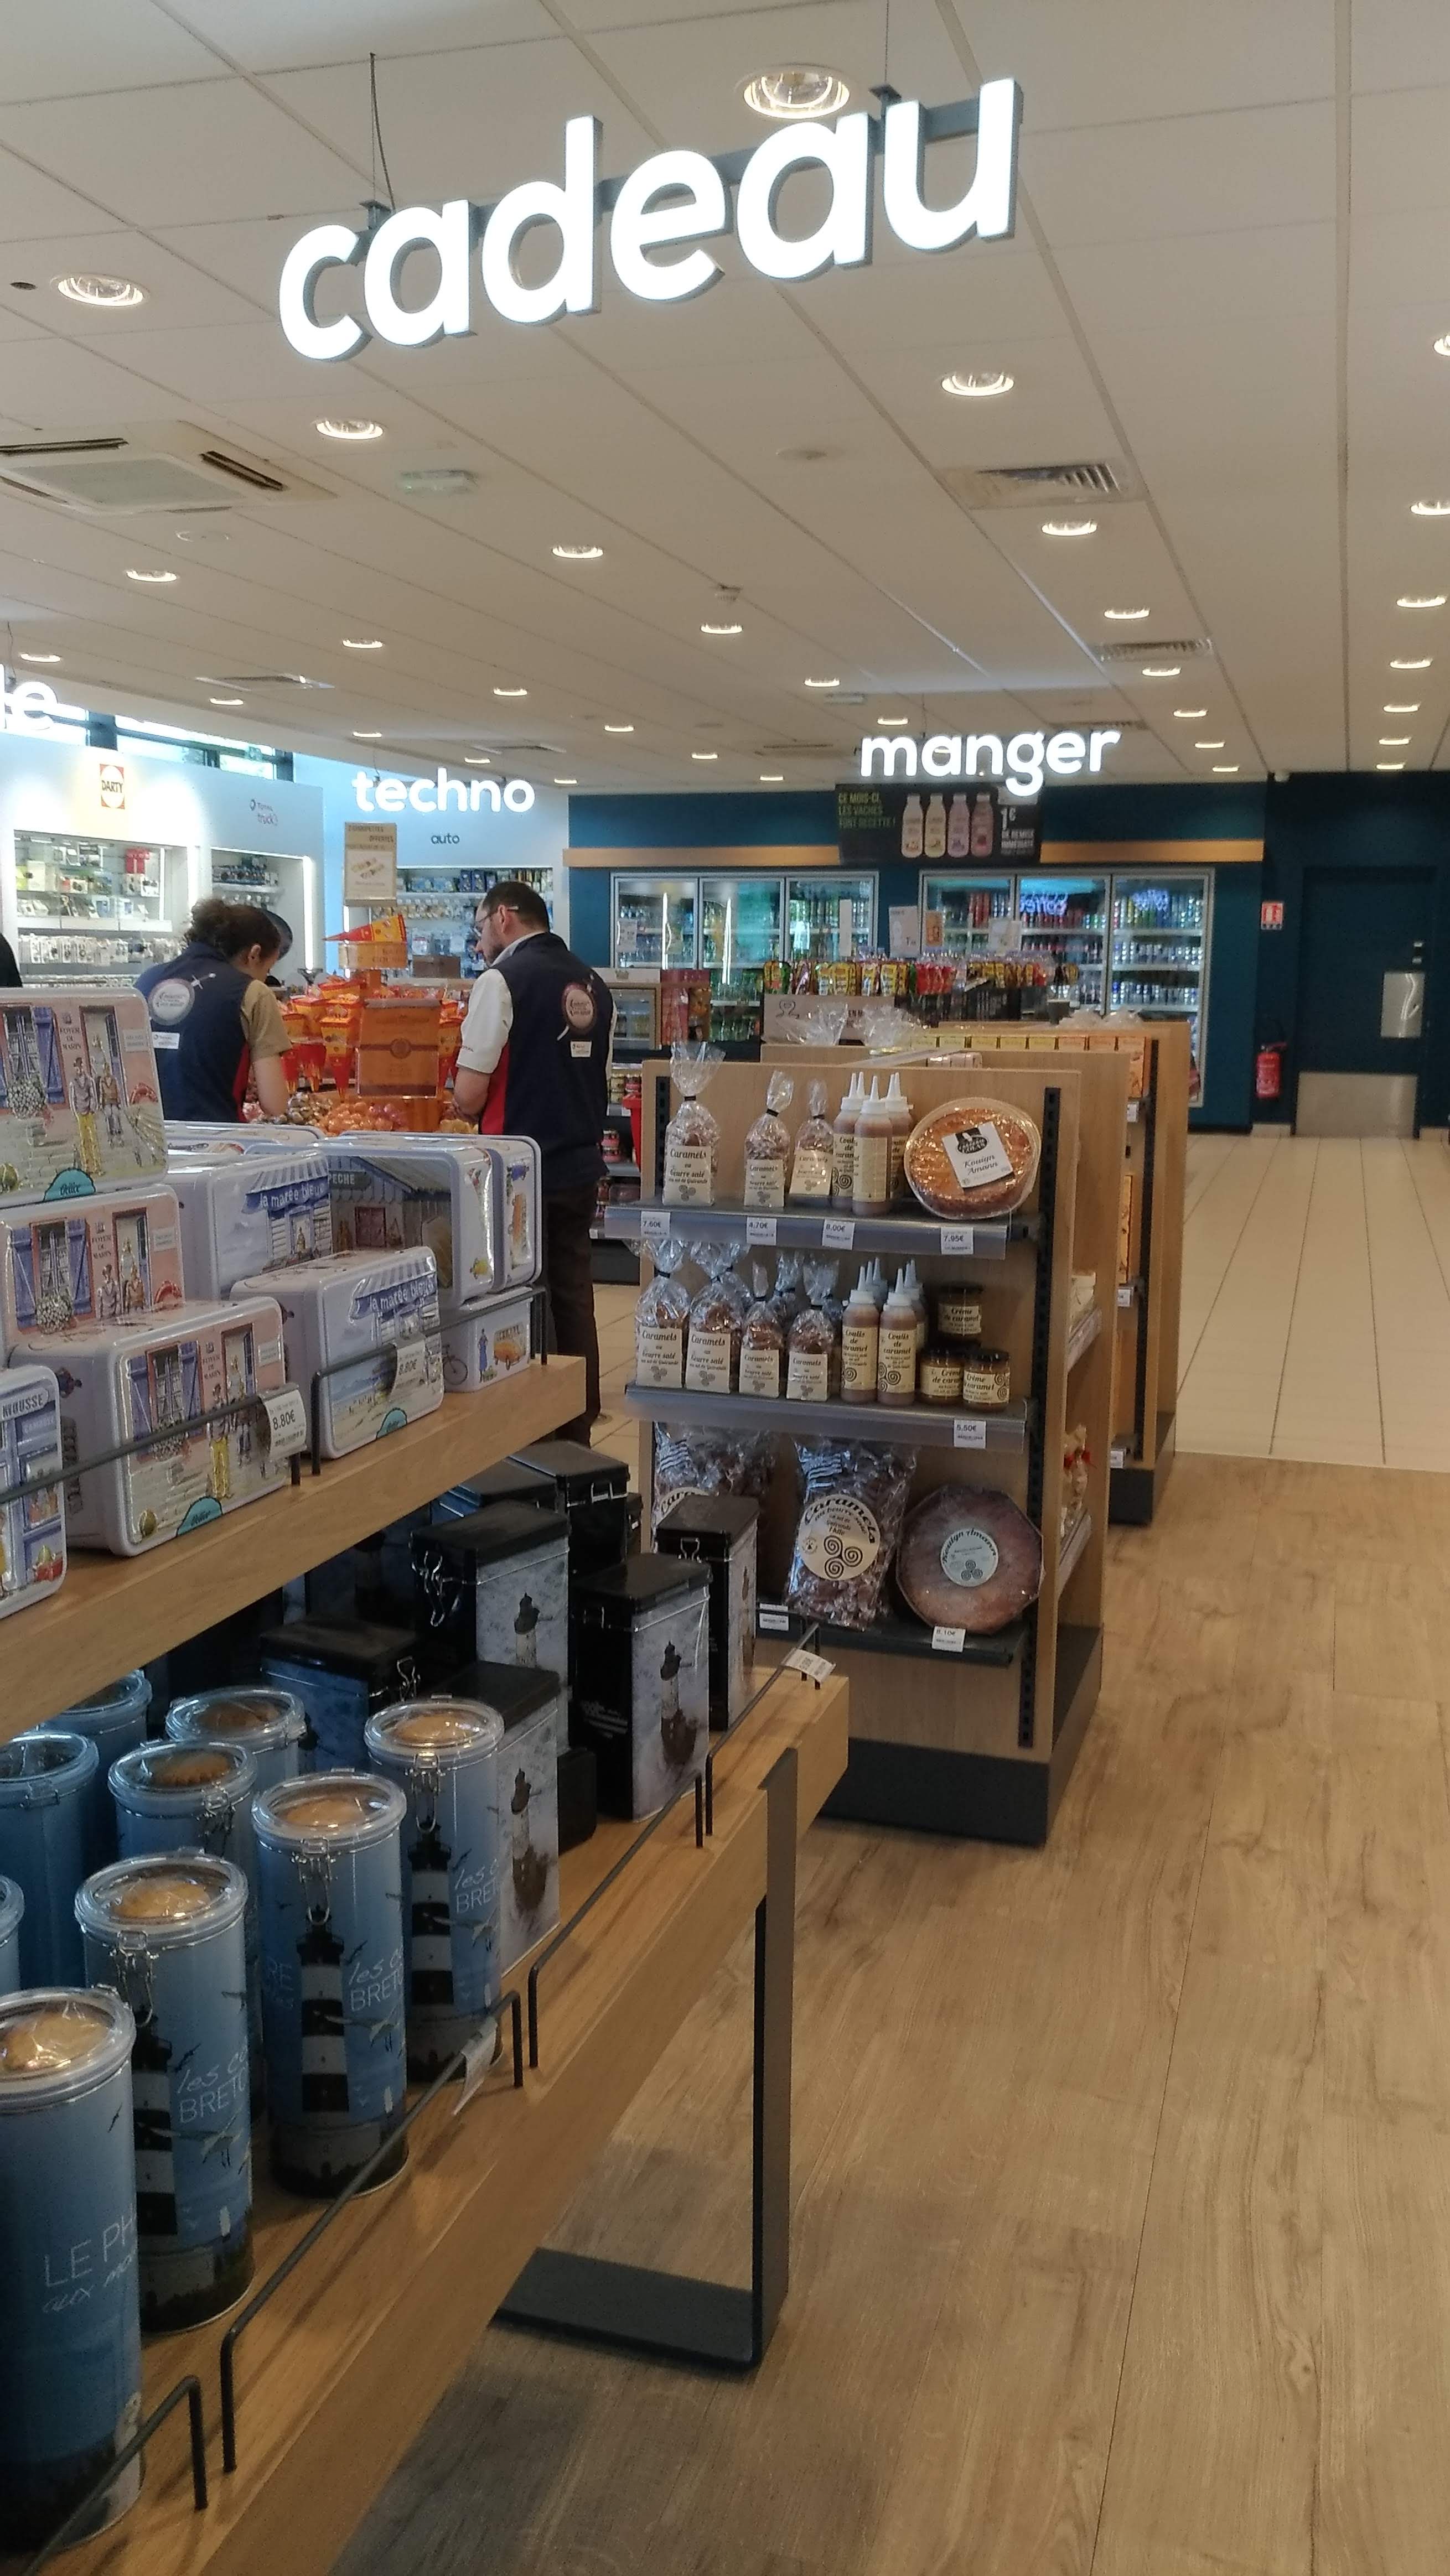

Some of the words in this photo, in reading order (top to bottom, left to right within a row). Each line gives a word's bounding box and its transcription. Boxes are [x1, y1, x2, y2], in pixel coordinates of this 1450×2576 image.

[278, 76, 1018, 363] cadeau
[860, 729, 1121, 796] manger
[101, 780, 123, 793] DARTY
[351, 767, 535, 812] techno
[431, 833, 460, 844] auto
[670, 1148, 707, 1159] Caramels
[260, 1193, 268, 1208] la
[826, 1223, 846, 1232] 8.00€
[370, 1295, 379, 1312] la
[642, 1330, 677, 1341] Caramels
[691, 1334, 726, 1346] Caramels
[744, 1354, 774, 1363] Caramels
[793, 1358, 821, 1366] Caramels
[272, 1409, 296, 1431] 8.80€
[805, 1498, 877, 1544] Caramels
[455, 1866, 485, 1891] les
[349, 1957, 384, 1986] les
[177, 2064, 219, 2094] les
[44, 2239, 94, 2287] LE
